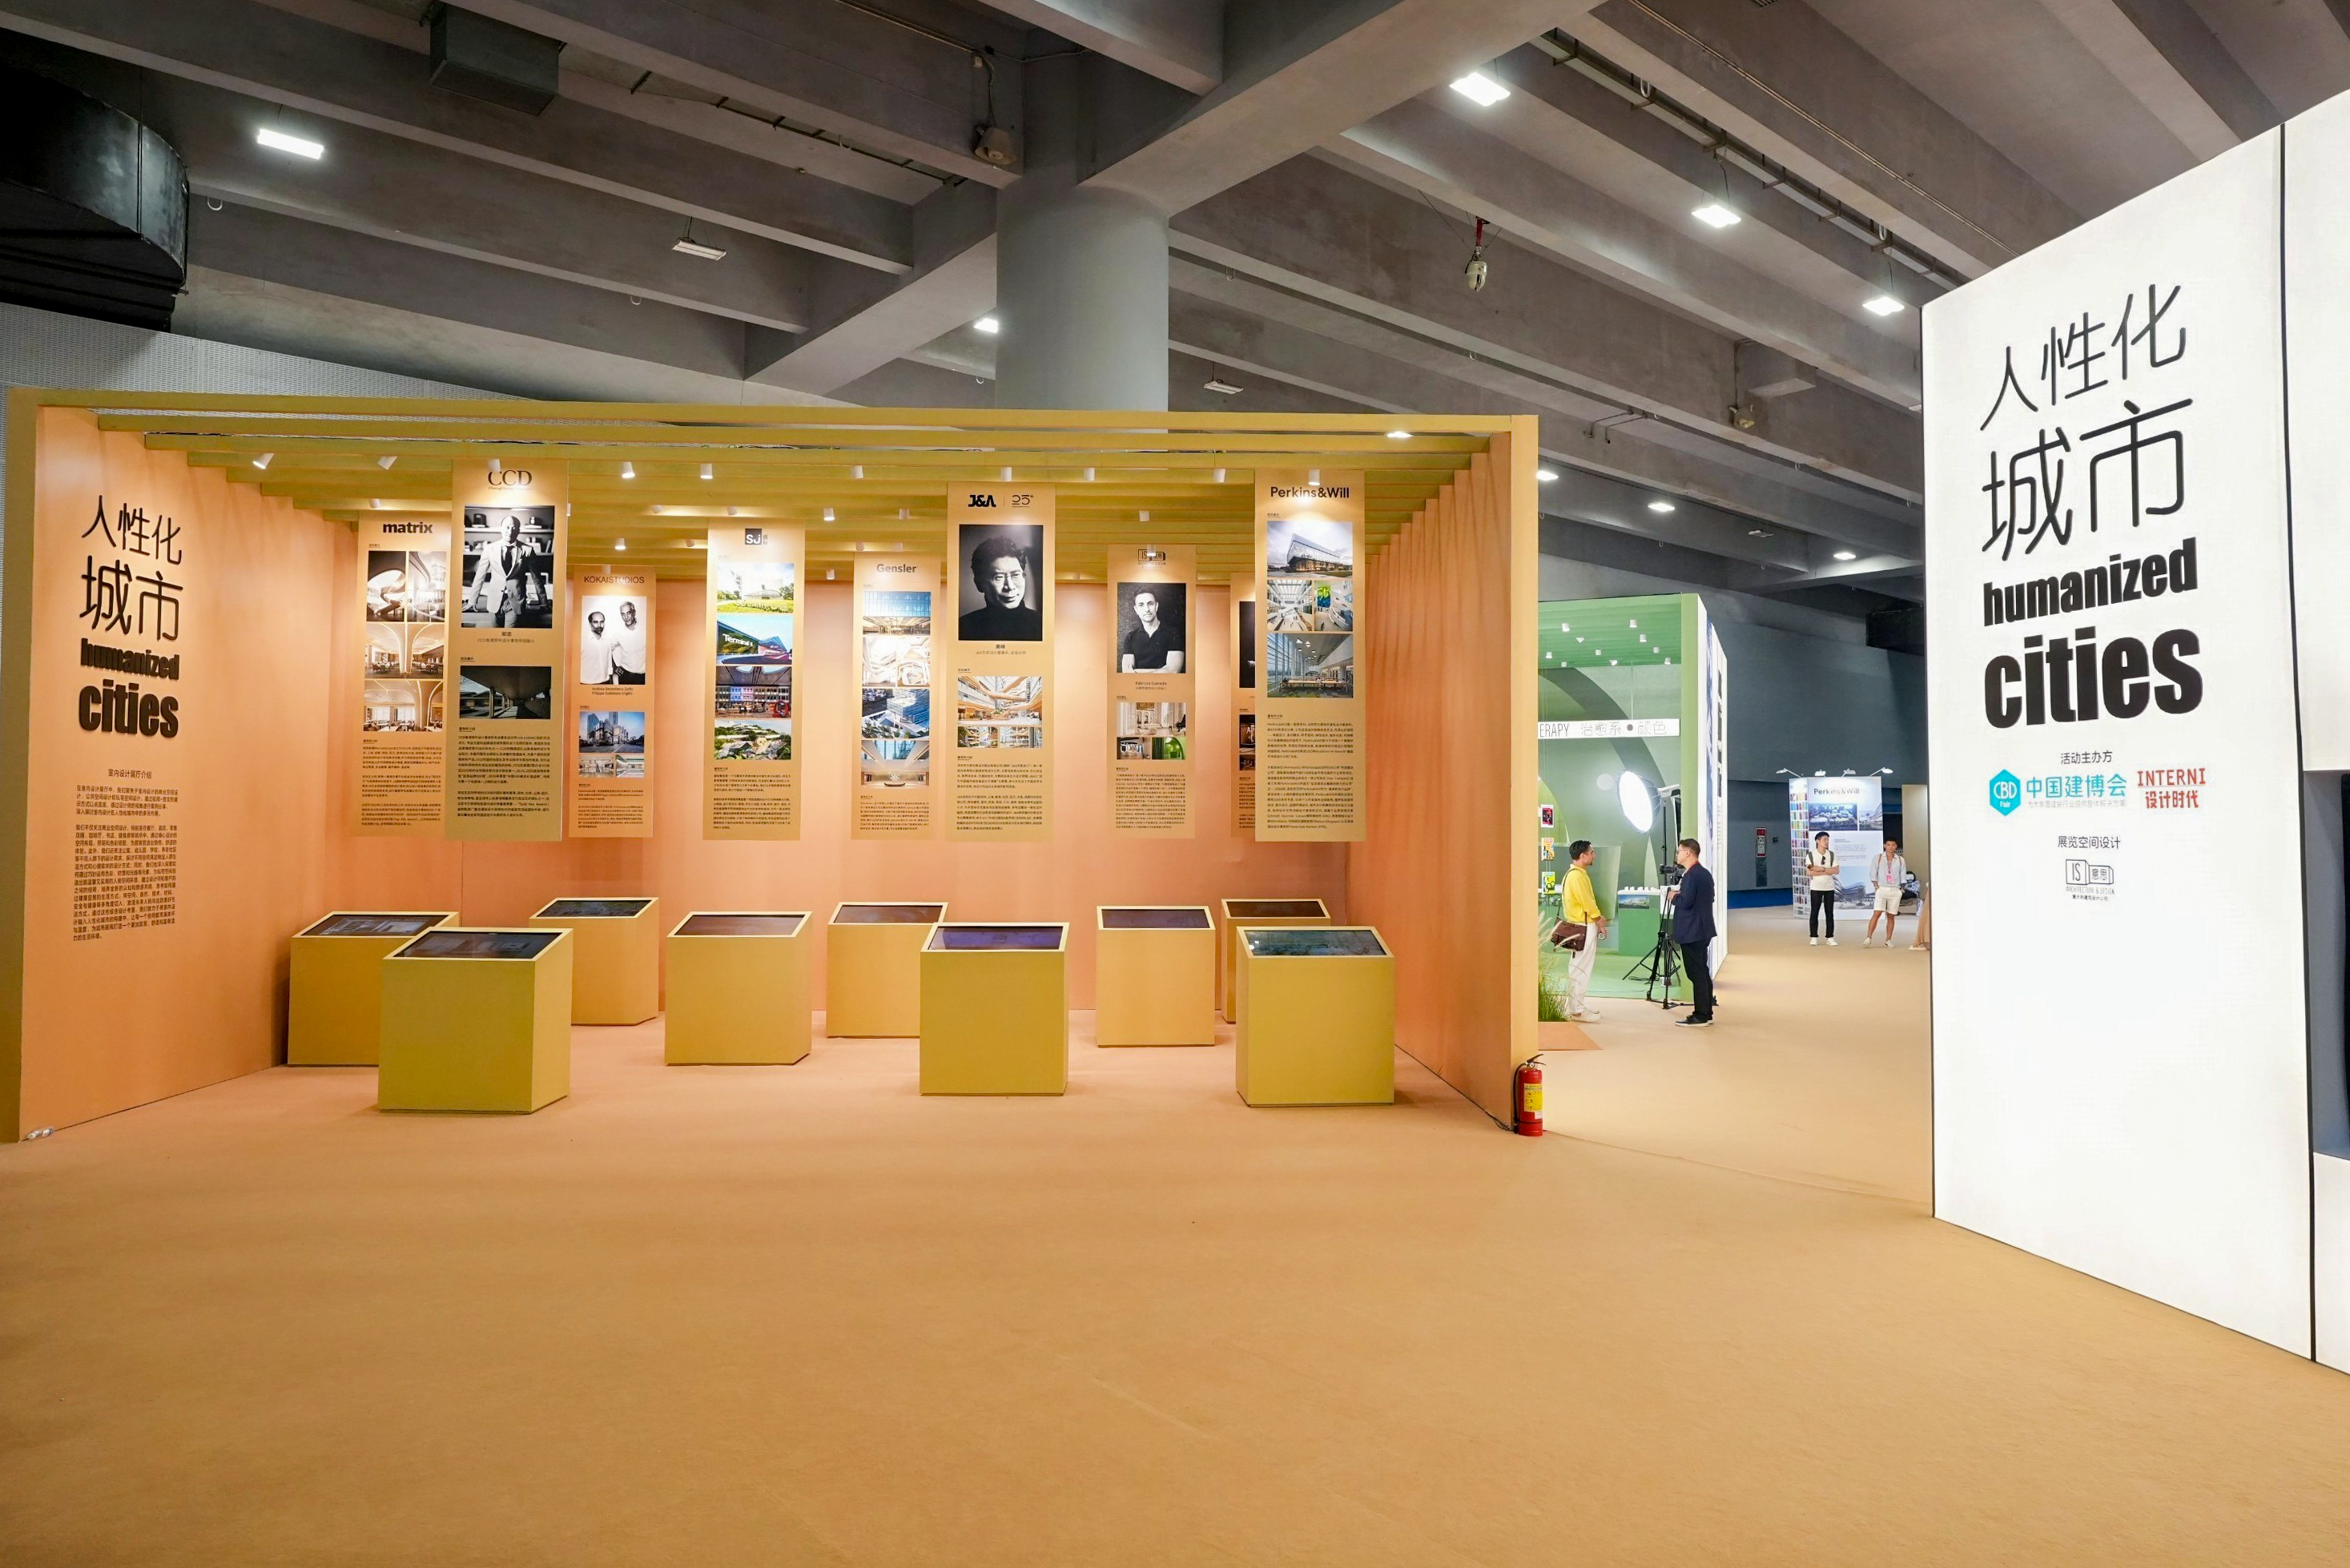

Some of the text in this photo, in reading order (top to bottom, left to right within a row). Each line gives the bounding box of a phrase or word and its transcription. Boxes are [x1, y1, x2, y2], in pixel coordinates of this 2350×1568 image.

[1980, 283, 2187, 430] 人性化
[488, 470, 532, 485] CCD
[1982, 398, 2193, 561] 城市
[968, 495, 996, 508] J&A
[1270, 486, 1350, 499] Perkins&Will
[82, 494, 182, 565] 人性化
[382, 521, 433, 533] matrix
[876, 564, 917, 573] Gensler
[583, 575, 645, 584] KOKAISTUDIOS
[1983, 537, 2198, 627] humanized
[79, 555, 183, 641] 城市
[722, 633, 750, 647] Terminal
[80, 637, 180, 681] humanized
[1984, 625, 2203, 729] cities
[78, 679, 179, 738] cities
[2060, 750, 2113, 765] 活动主办方
[108, 769, 152, 779] 室内设计展厅介绍
[2137, 767, 2206, 787] INTERNI
[1993, 781, 2018, 799] CBD
[2026, 773, 2127, 798] 中国建博会
[2146, 790, 2199, 809] 设计时代
[2058, 836, 2121, 850] 展览空间设计
[2072, 862, 2081, 881] IS
